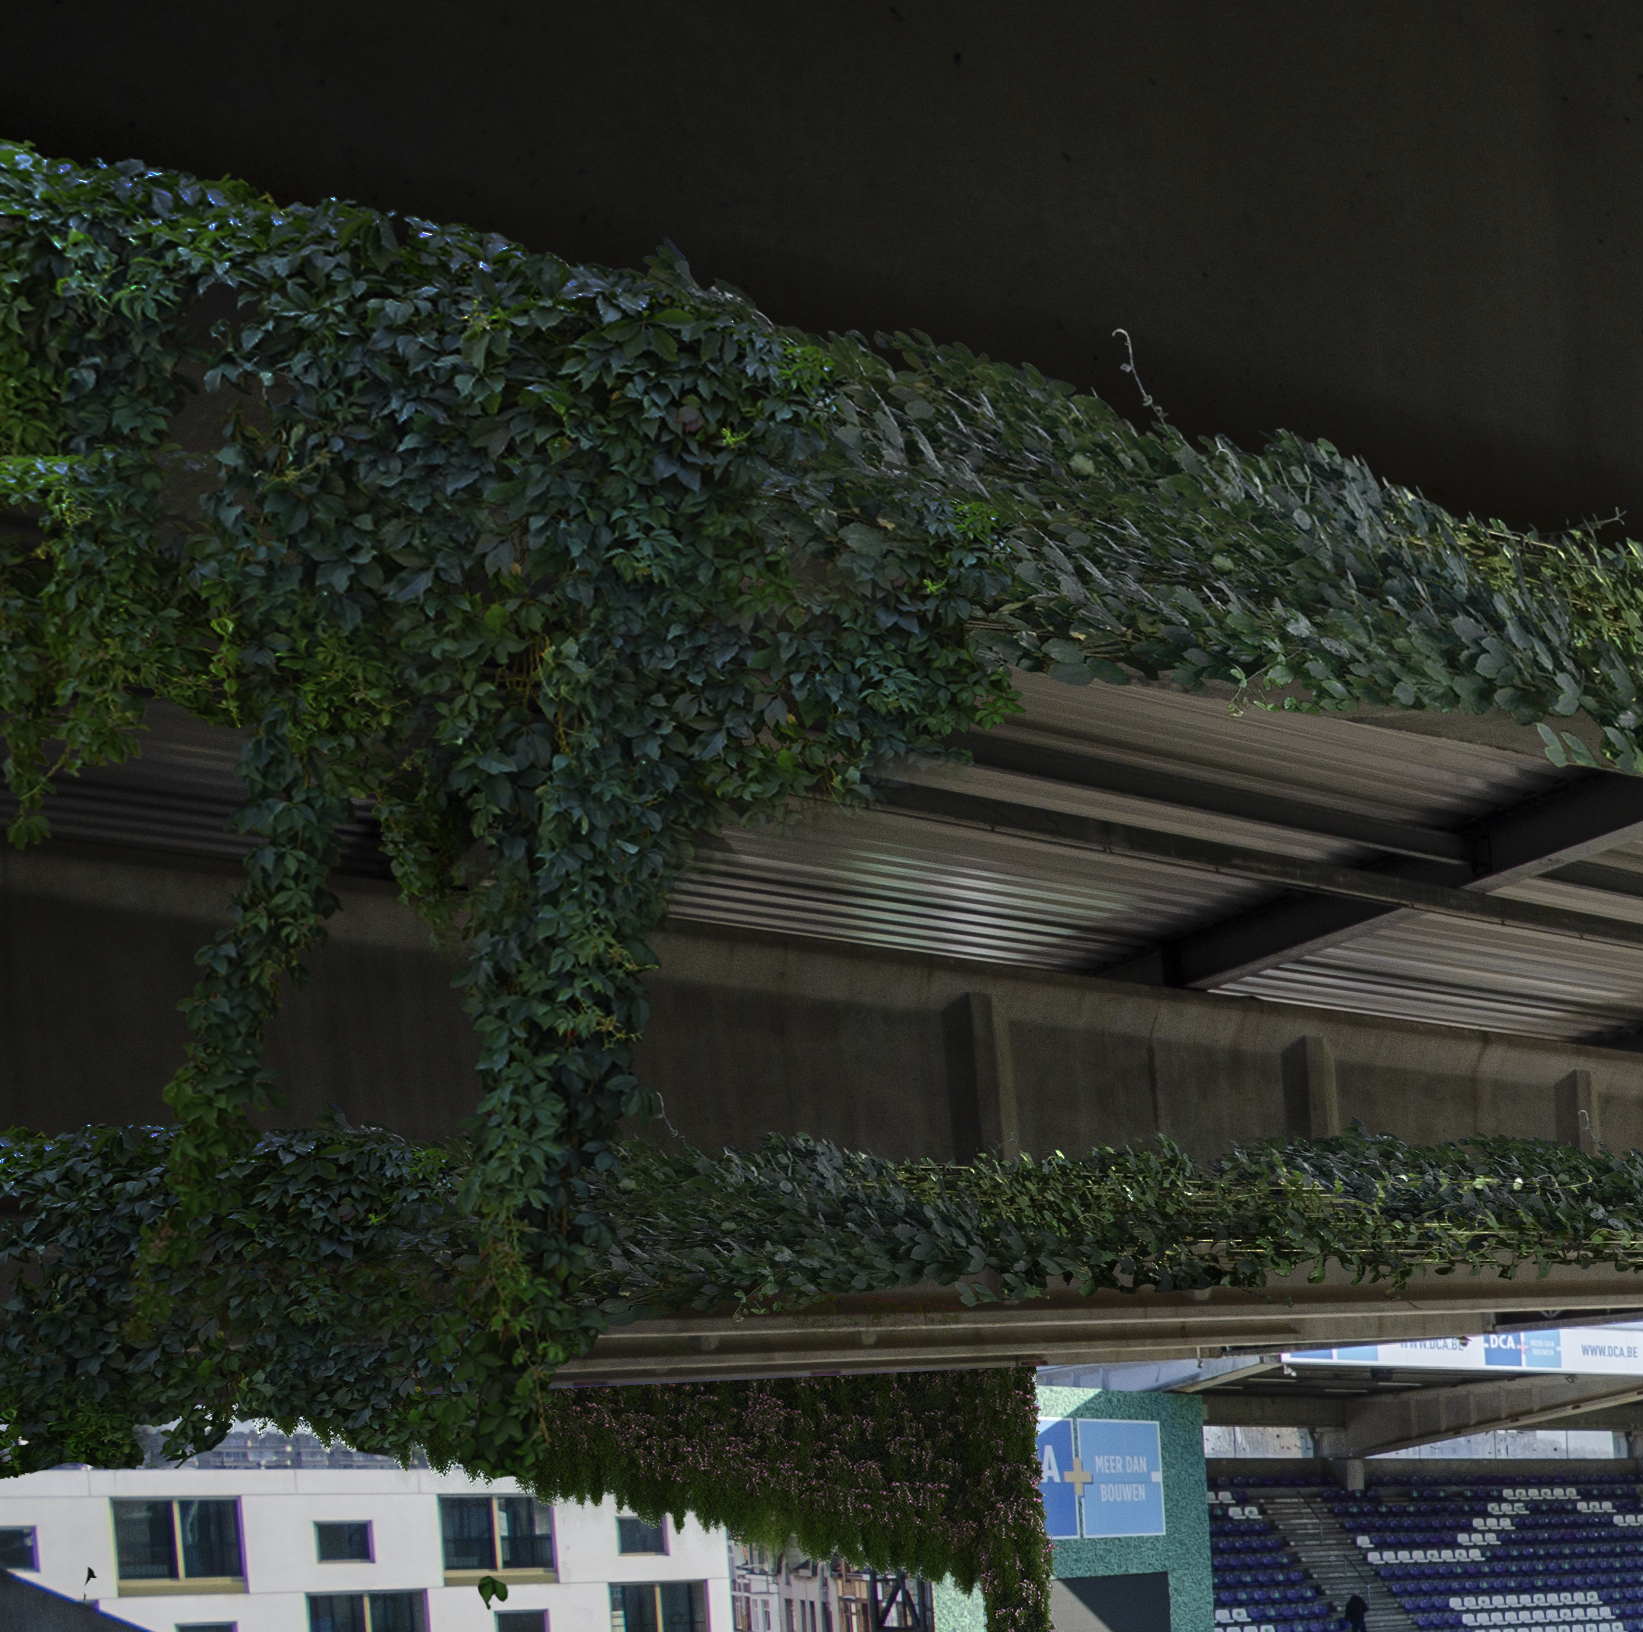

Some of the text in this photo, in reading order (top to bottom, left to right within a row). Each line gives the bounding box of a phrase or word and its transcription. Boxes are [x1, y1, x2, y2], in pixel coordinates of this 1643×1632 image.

[1581, 1343, 1638, 1359] WWW.DCA.BE
[1095, 1455, 1148, 1473] MEER DAN
[1100, 1483, 1146, 1502] BOUWEN
